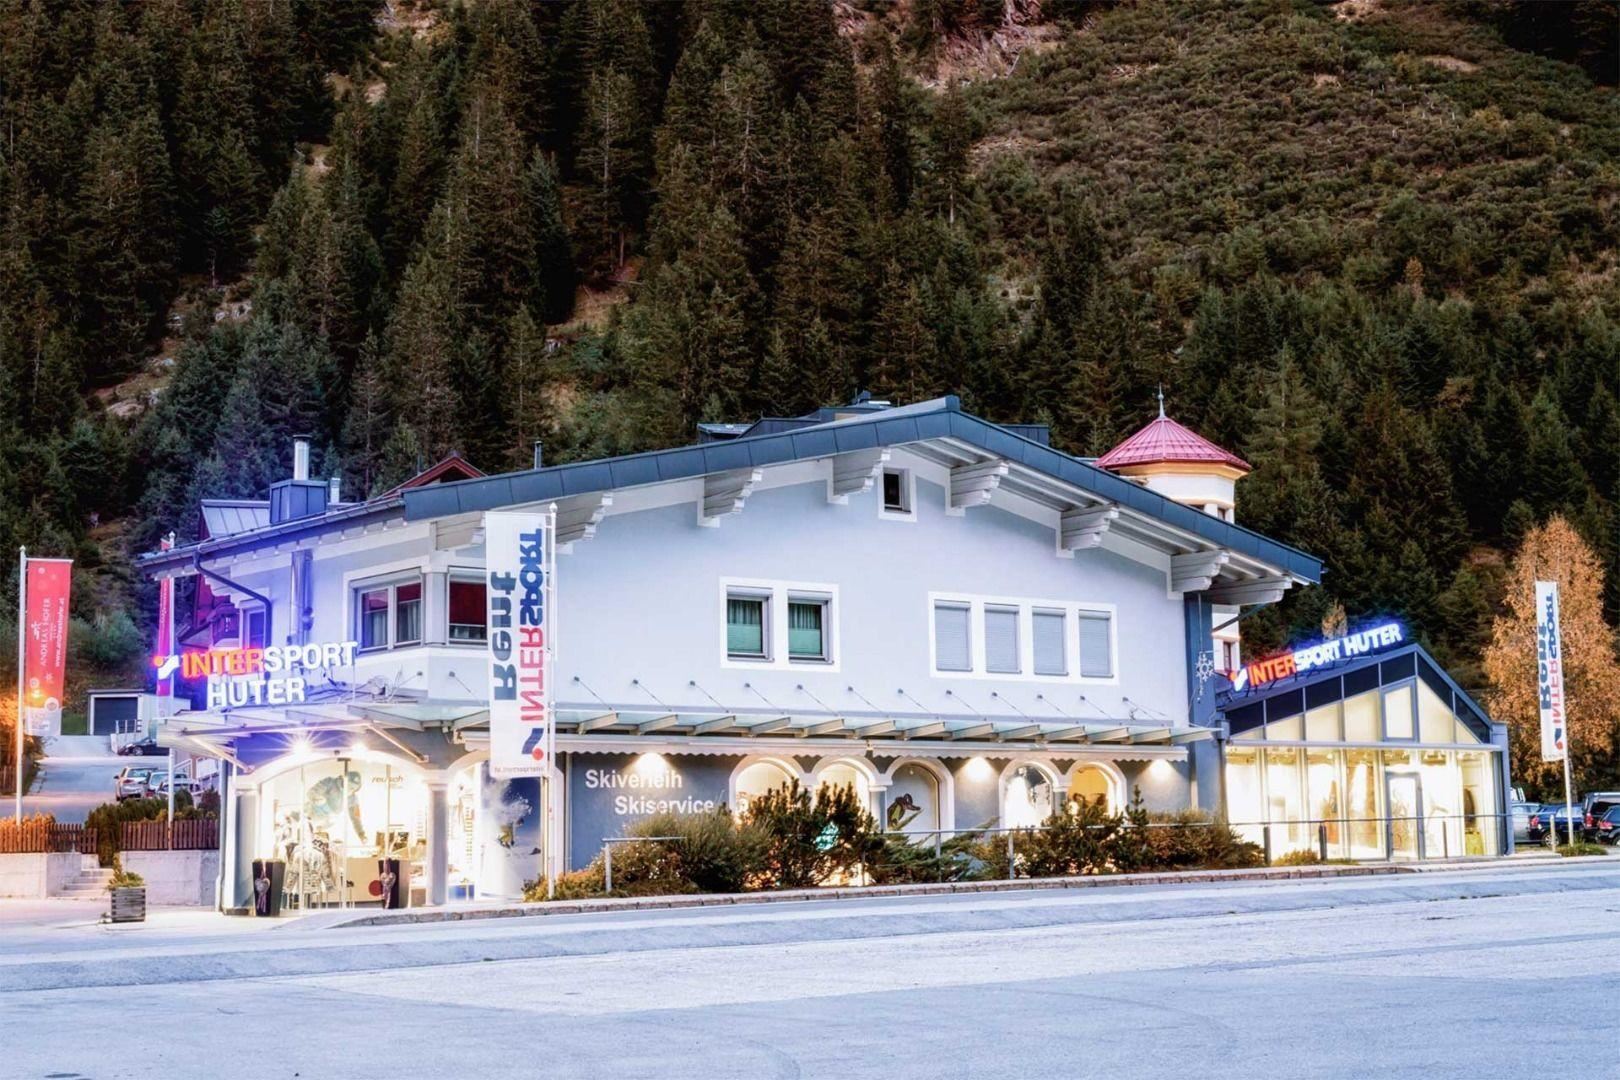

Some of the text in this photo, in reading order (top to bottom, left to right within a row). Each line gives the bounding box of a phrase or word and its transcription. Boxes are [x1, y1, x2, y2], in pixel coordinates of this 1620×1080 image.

[183, 642, 358, 678] INTERSPORT
[1250, 623, 1402, 686] INTERSPORT HUTER
[207, 677, 305, 708] HUTER
[614, 796, 714, 815] Skiservice
